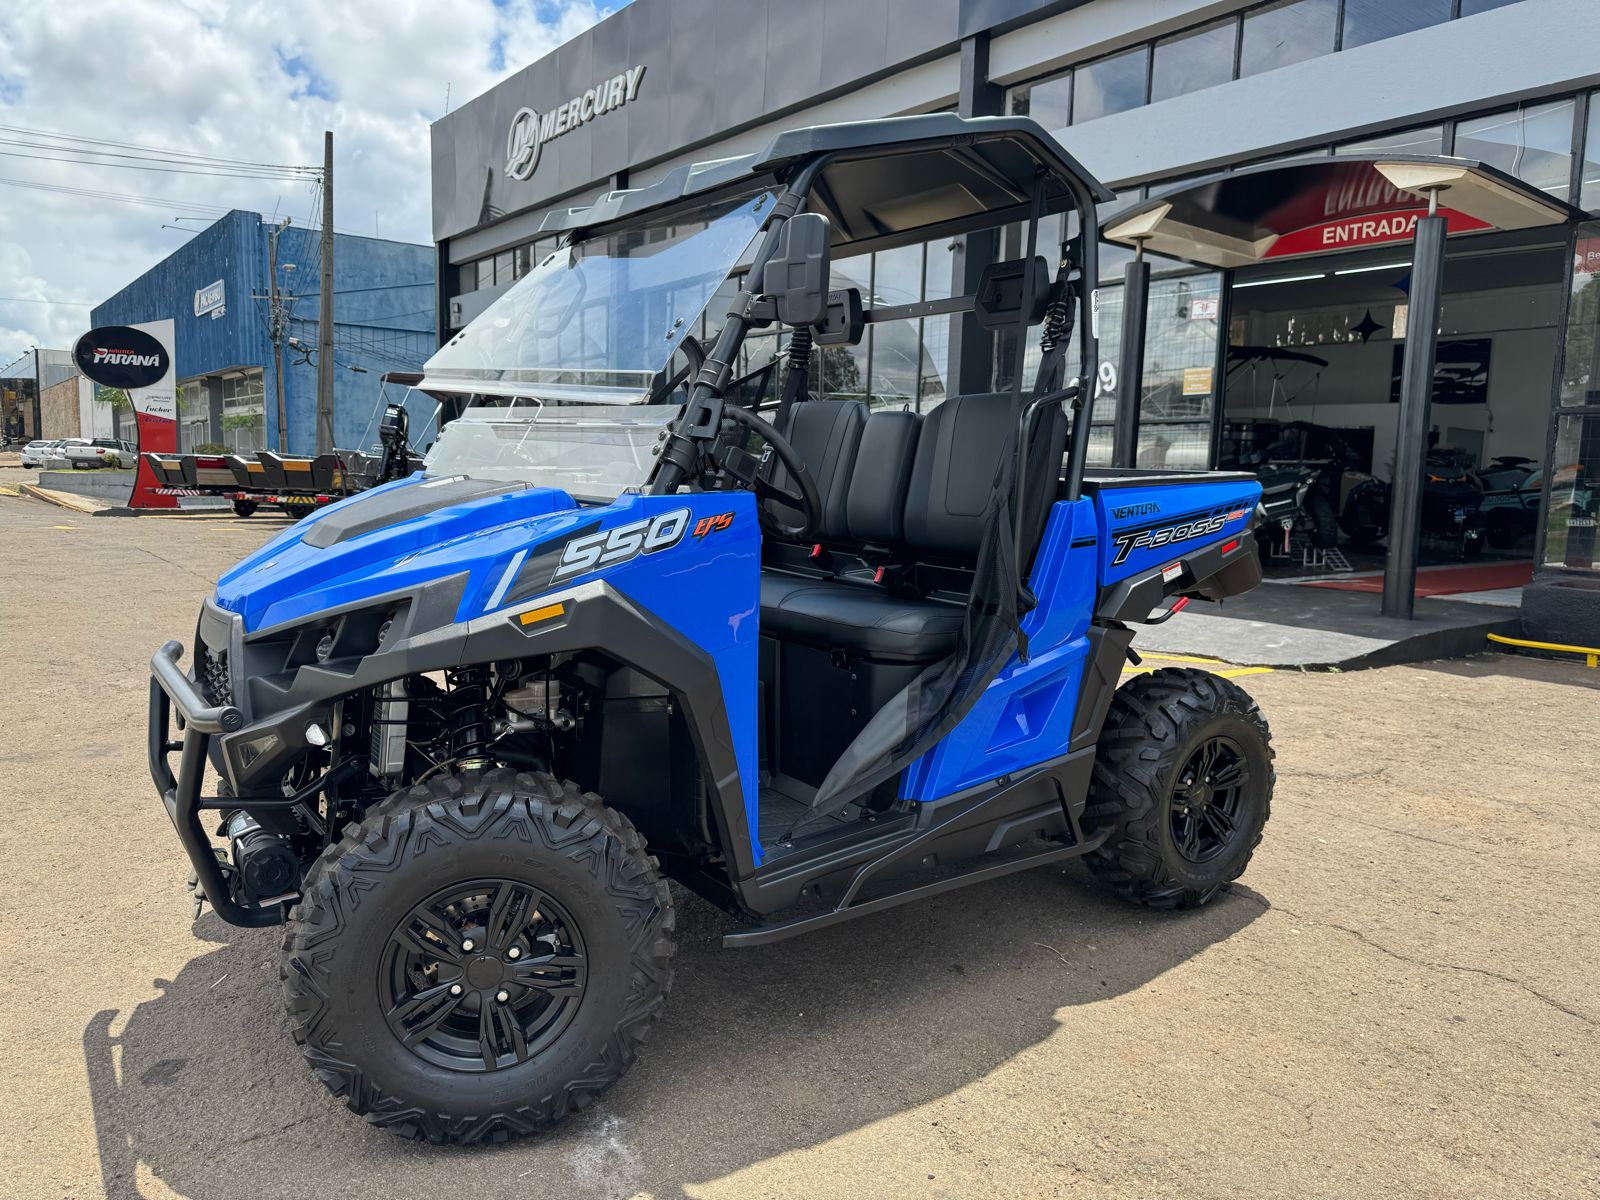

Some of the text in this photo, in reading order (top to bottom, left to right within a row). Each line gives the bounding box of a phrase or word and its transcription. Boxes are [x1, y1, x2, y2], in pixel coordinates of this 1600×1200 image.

[538, 65, 646, 144] MERCURY
[1323, 215, 1418, 244] ENTRADA
[93, 347, 160, 367] PARANÁ
[1109, 502, 1160, 520] VENTURA
[552, 508, 736, 581] 550 EPS
[1111, 513, 1228, 567] T-BOSS
